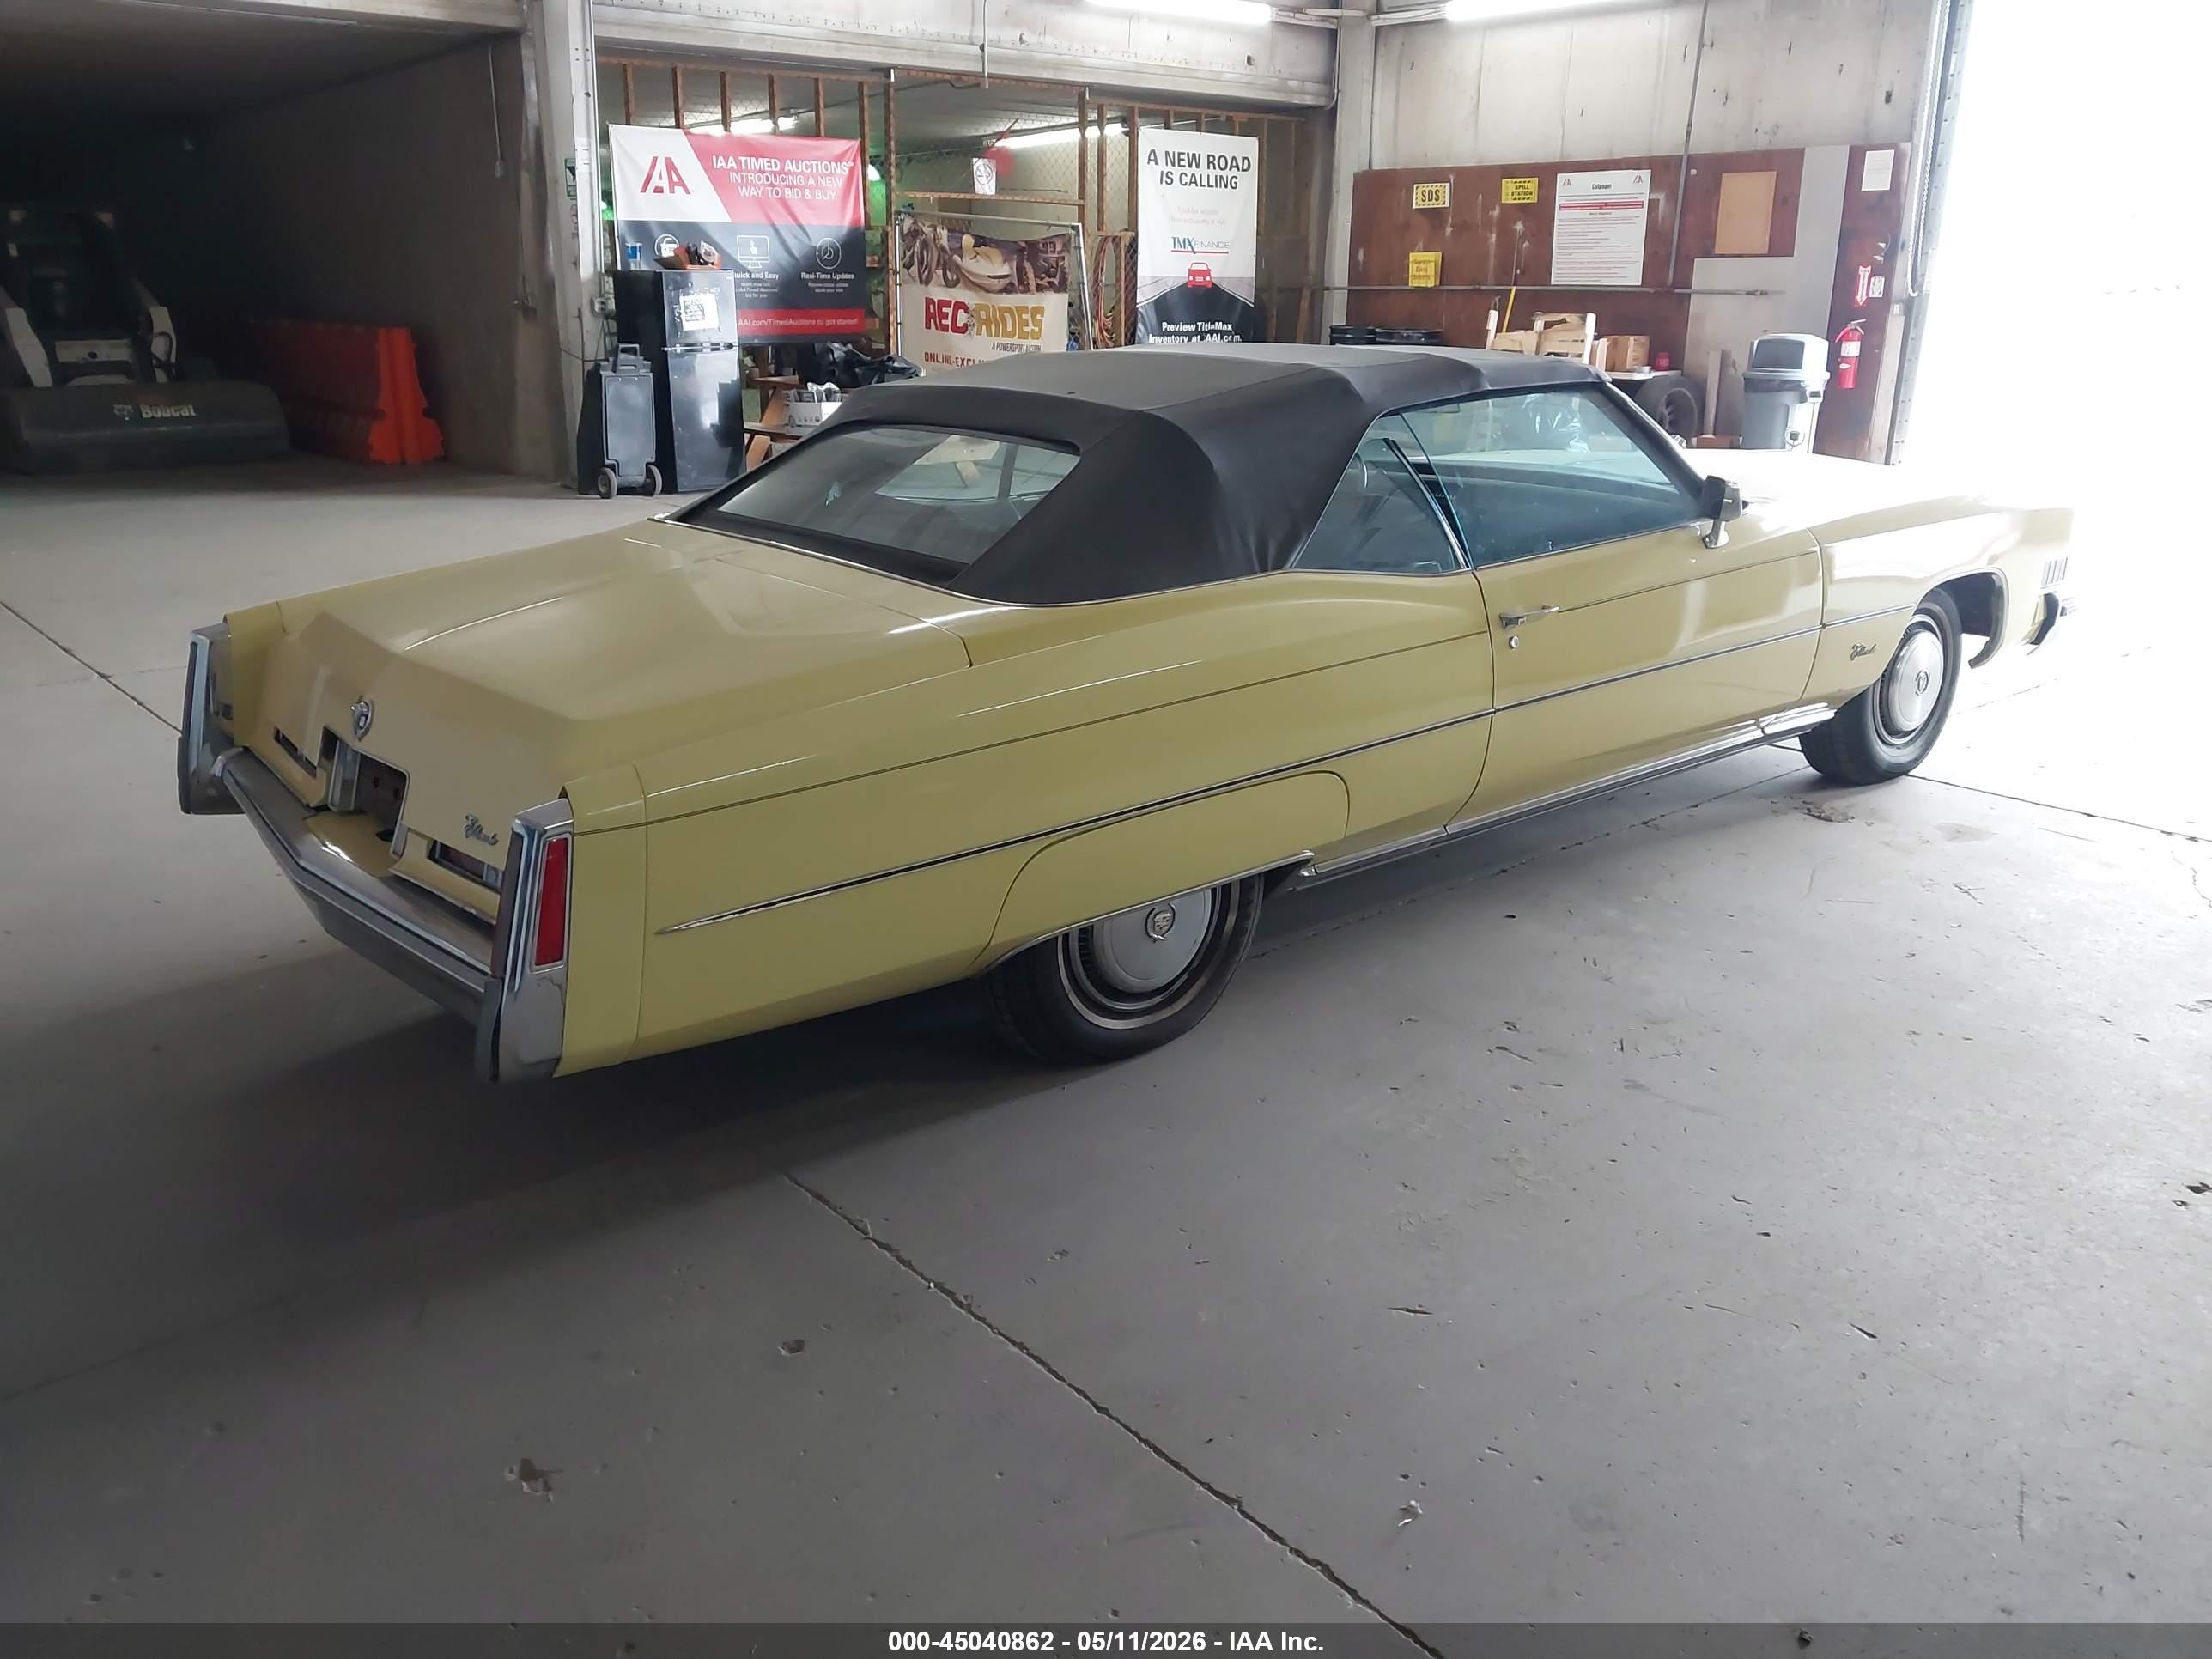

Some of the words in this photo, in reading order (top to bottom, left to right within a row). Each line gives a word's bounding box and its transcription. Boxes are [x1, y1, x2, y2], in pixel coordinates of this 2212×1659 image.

[712, 155, 737, 169] IAA
[738, 156, 780, 172] TIMED
[1147, 149, 1158, 166] A
[1164, 150, 1201, 169] NEW
[1206, 154, 1251, 173] ROAD
[730, 172, 805, 186] INTRODUCING
[807, 176, 816, 186] A
[817, 176, 842, 188] NEW
[1159, 170, 1174, 185] IS
[1179, 172, 1238, 190] CALLING
[738, 185, 763, 198] WAY
[766, 186, 781, 198] TO
[785, 187, 801, 199] BID
[804, 188, 812, 199] &
[815, 189, 837, 200] BUY
[1421, 189, 1440, 203] SDS
[1194, 240, 1230, 249] FINANCE
[764, 271, 779, 280] Easy
[925, 296, 969, 335] REC
[974, 302, 1045, 341] RIDES
[1162, 321, 1196, 331] Preview
[1148, 333, 1189, 343] Inventory
[140, 404, 196, 418] Bobcat
